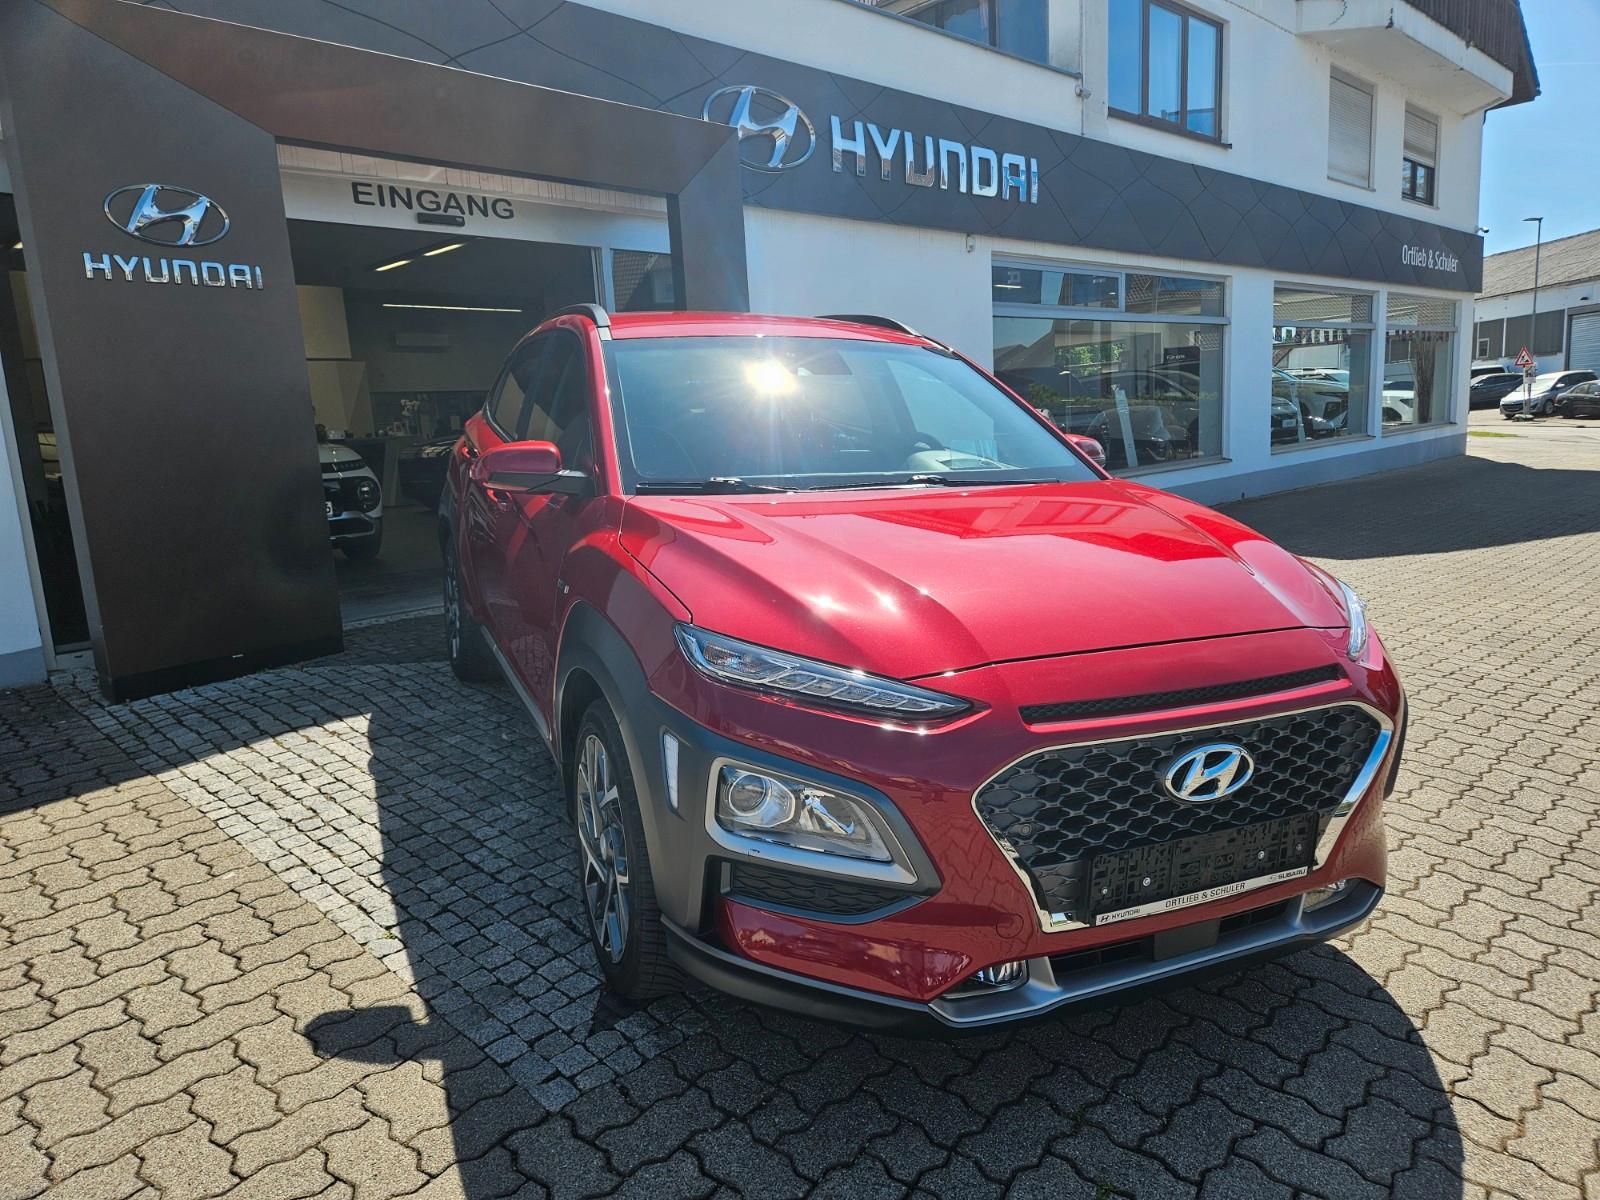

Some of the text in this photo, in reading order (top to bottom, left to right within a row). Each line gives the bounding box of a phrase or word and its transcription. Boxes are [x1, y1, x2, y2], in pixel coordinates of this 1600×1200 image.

[830, 114, 1038, 204] HYUNDAI
[351, 181, 515, 220] EINGANG
[1402, 244, 1427, 267] Ortlieb
[1428, 249, 1434, 269] &
[82, 252, 264, 290] HYUNDAI
[1278, 868, 1306, 880] SUBARU
[1165, 882, 1246, 908] ORTLIEB & SCHULER
[1111, 908, 1141, 920] HYUNDAI
